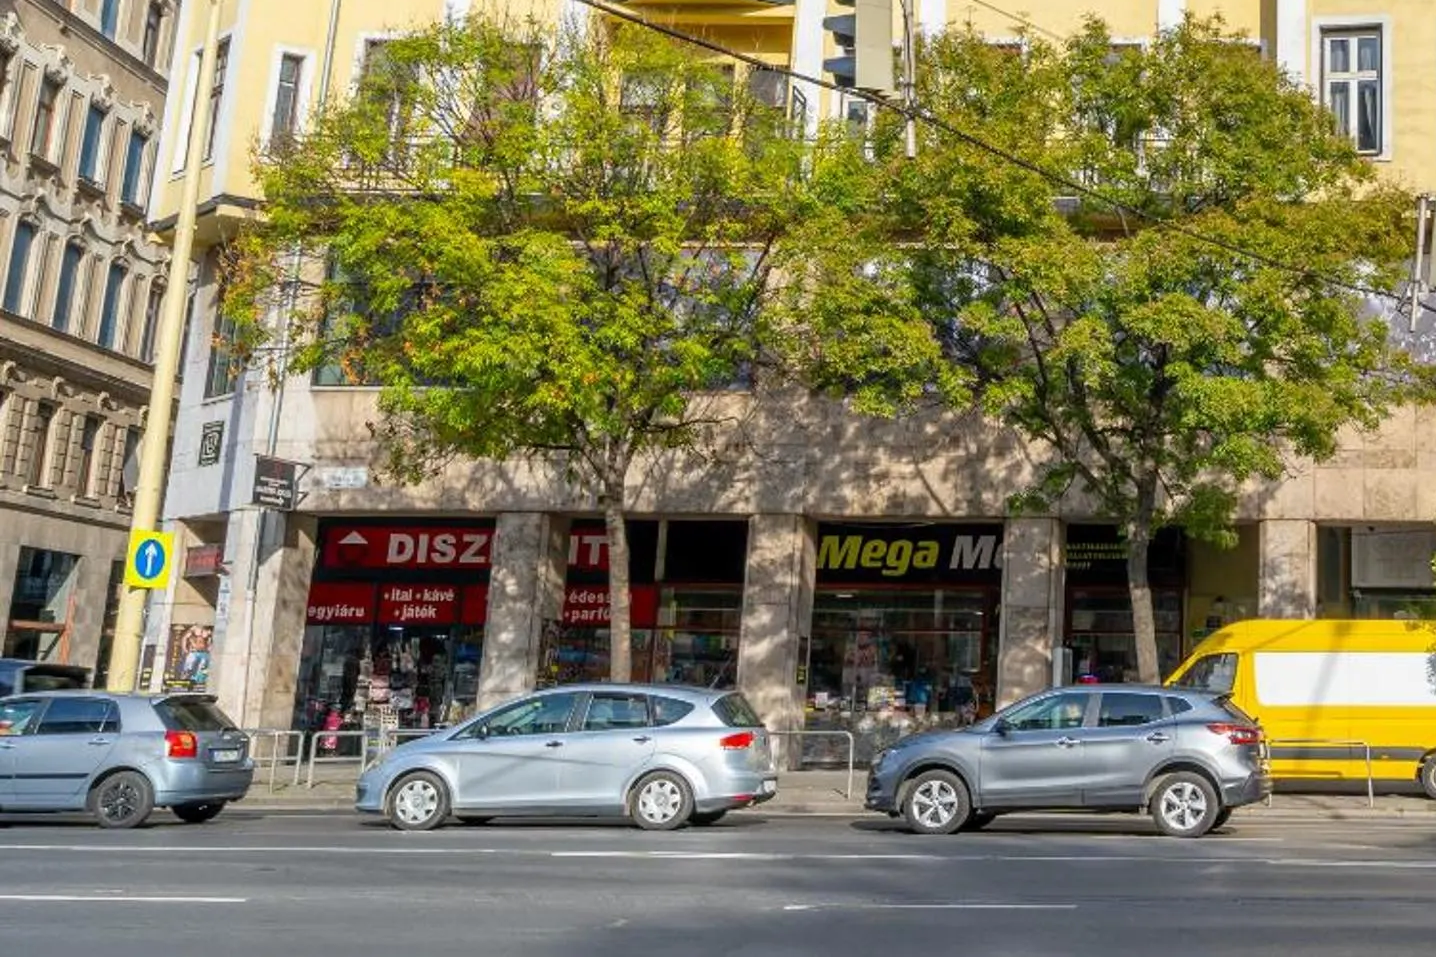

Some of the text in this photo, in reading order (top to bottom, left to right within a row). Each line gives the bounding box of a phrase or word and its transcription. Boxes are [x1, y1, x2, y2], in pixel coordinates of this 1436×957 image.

[817, 535, 940, 576] Mega
[391, 588, 454, 602] ital kávé
[307, 603, 365, 621] egyiáru
